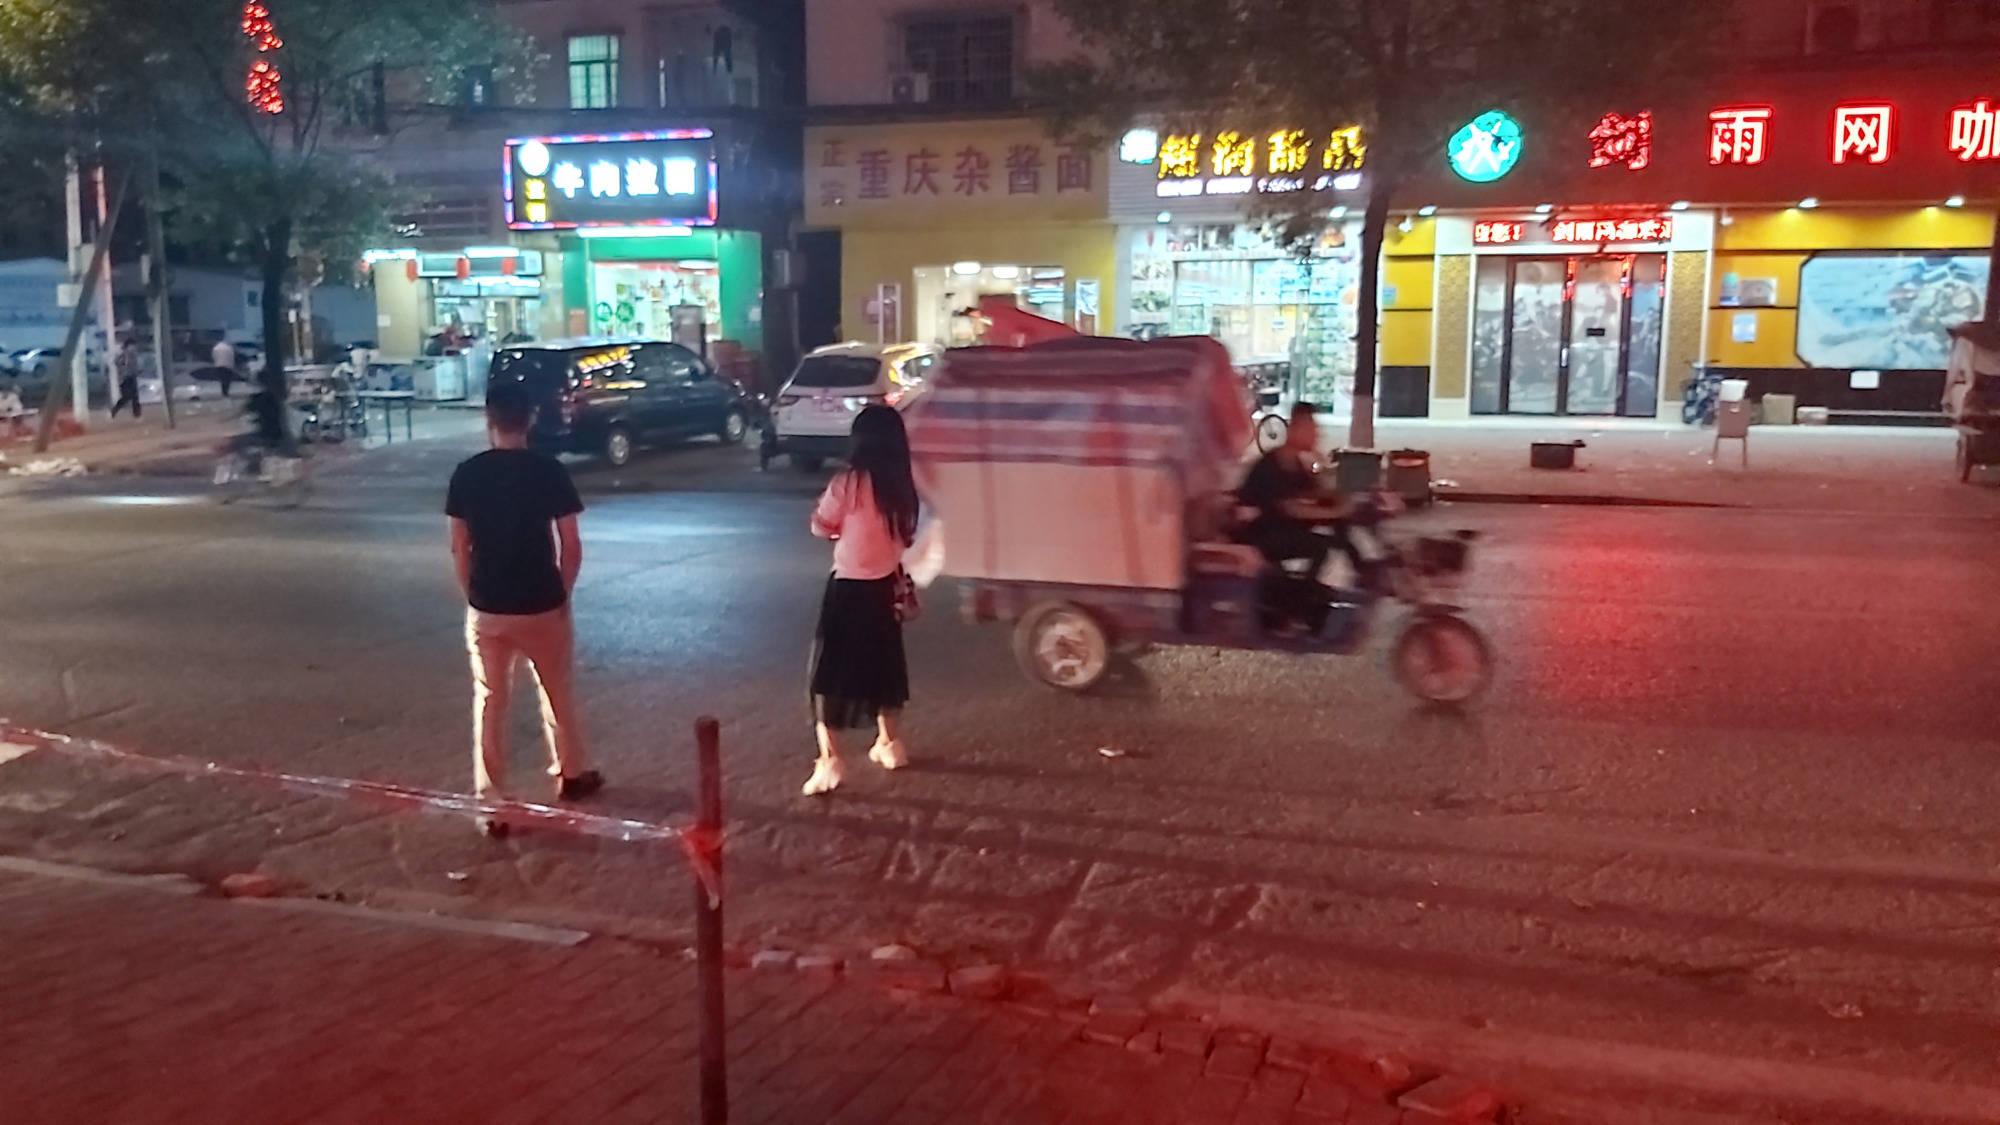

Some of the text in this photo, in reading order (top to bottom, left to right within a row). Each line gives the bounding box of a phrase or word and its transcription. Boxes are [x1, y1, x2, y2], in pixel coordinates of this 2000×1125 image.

[1588, 99, 2000, 170] 剑雨网咖
[856, 137, 1093, 199] 重庆杂酱面
